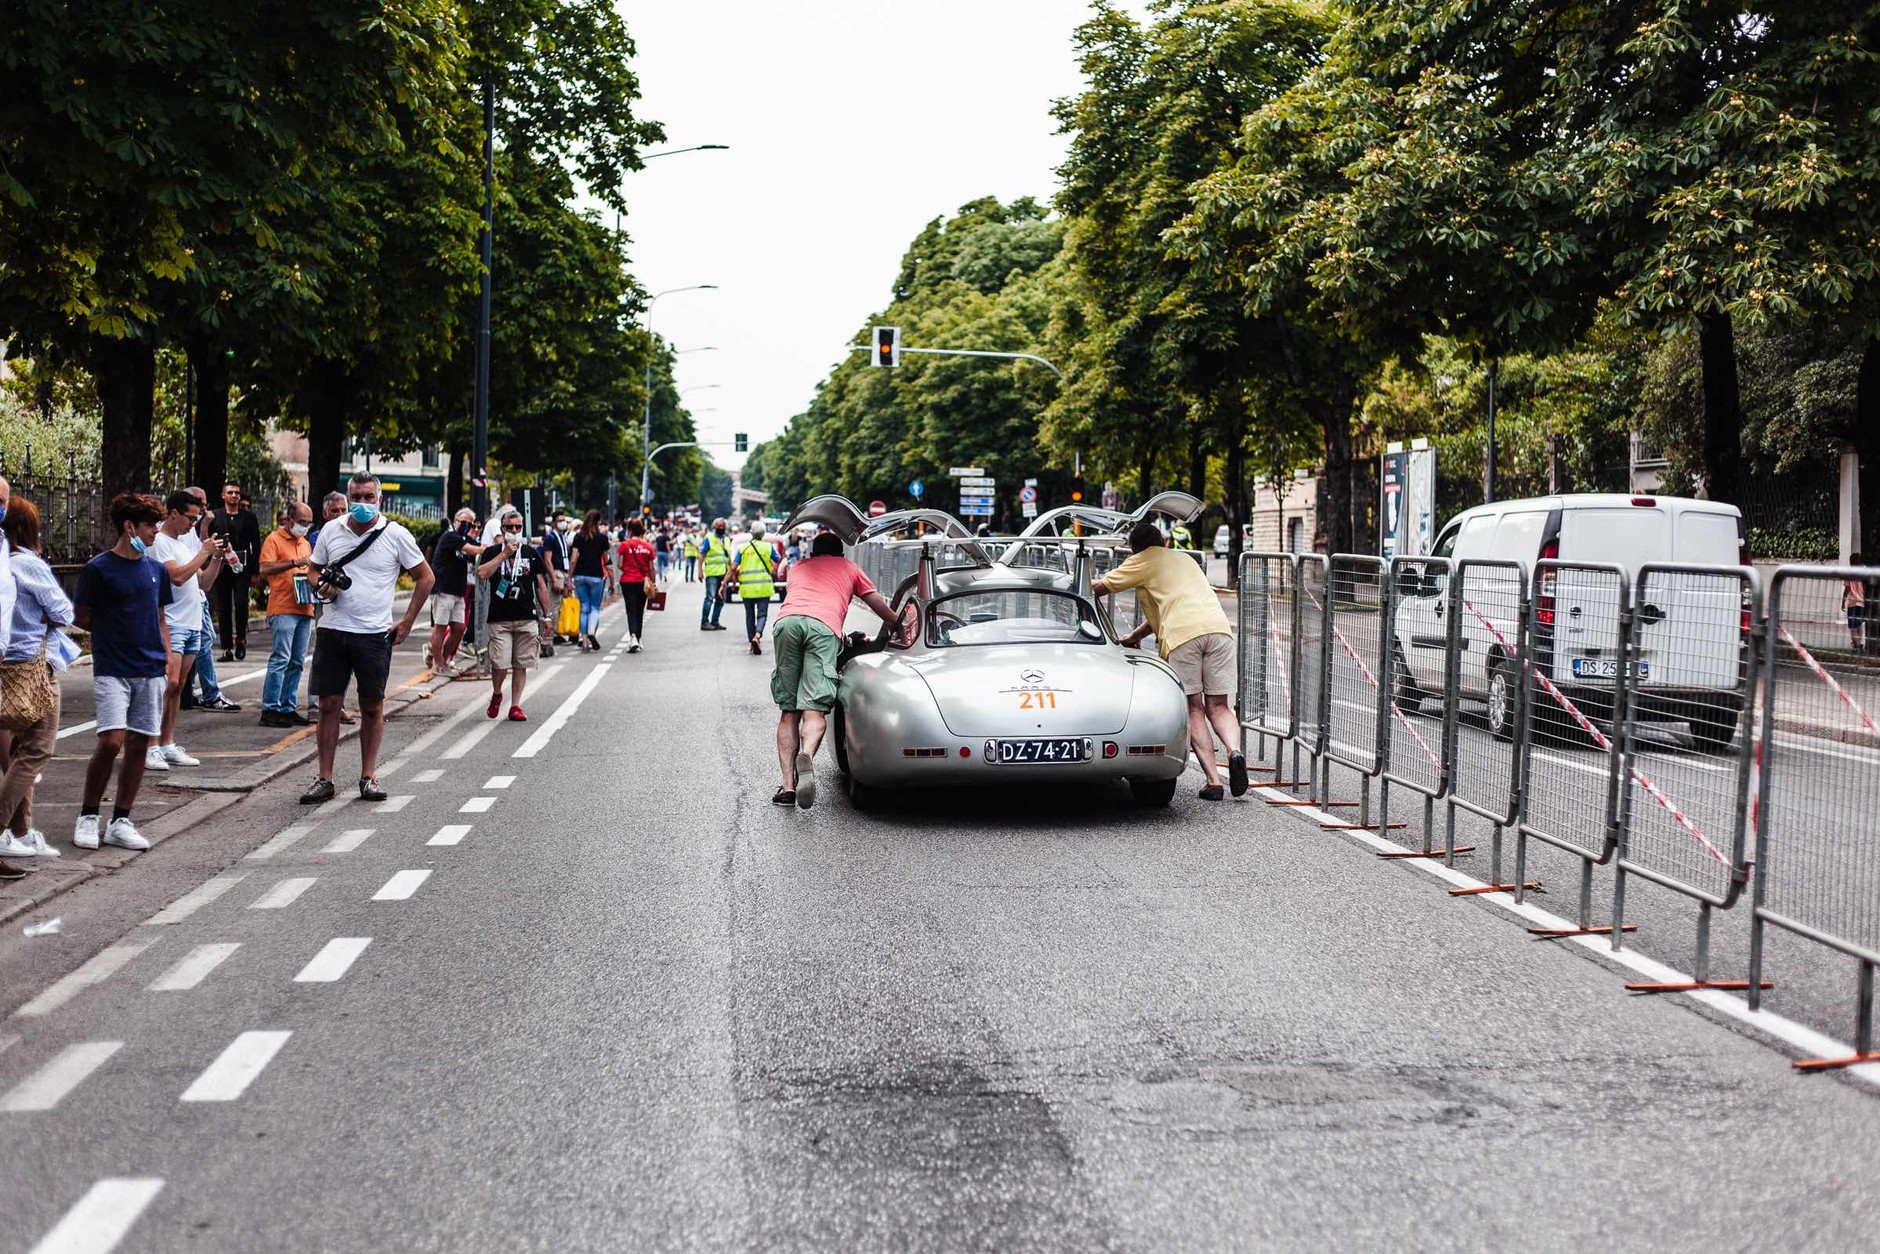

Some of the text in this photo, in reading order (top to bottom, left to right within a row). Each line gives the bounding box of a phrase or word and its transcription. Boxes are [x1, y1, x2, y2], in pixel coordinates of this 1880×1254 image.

[1583, 661, 1597, 674] DS
[1602, 661, 1617, 675] 25
[1018, 691, 1056, 709] 211
[1002, 742, 1077, 760] DZ-74-21
